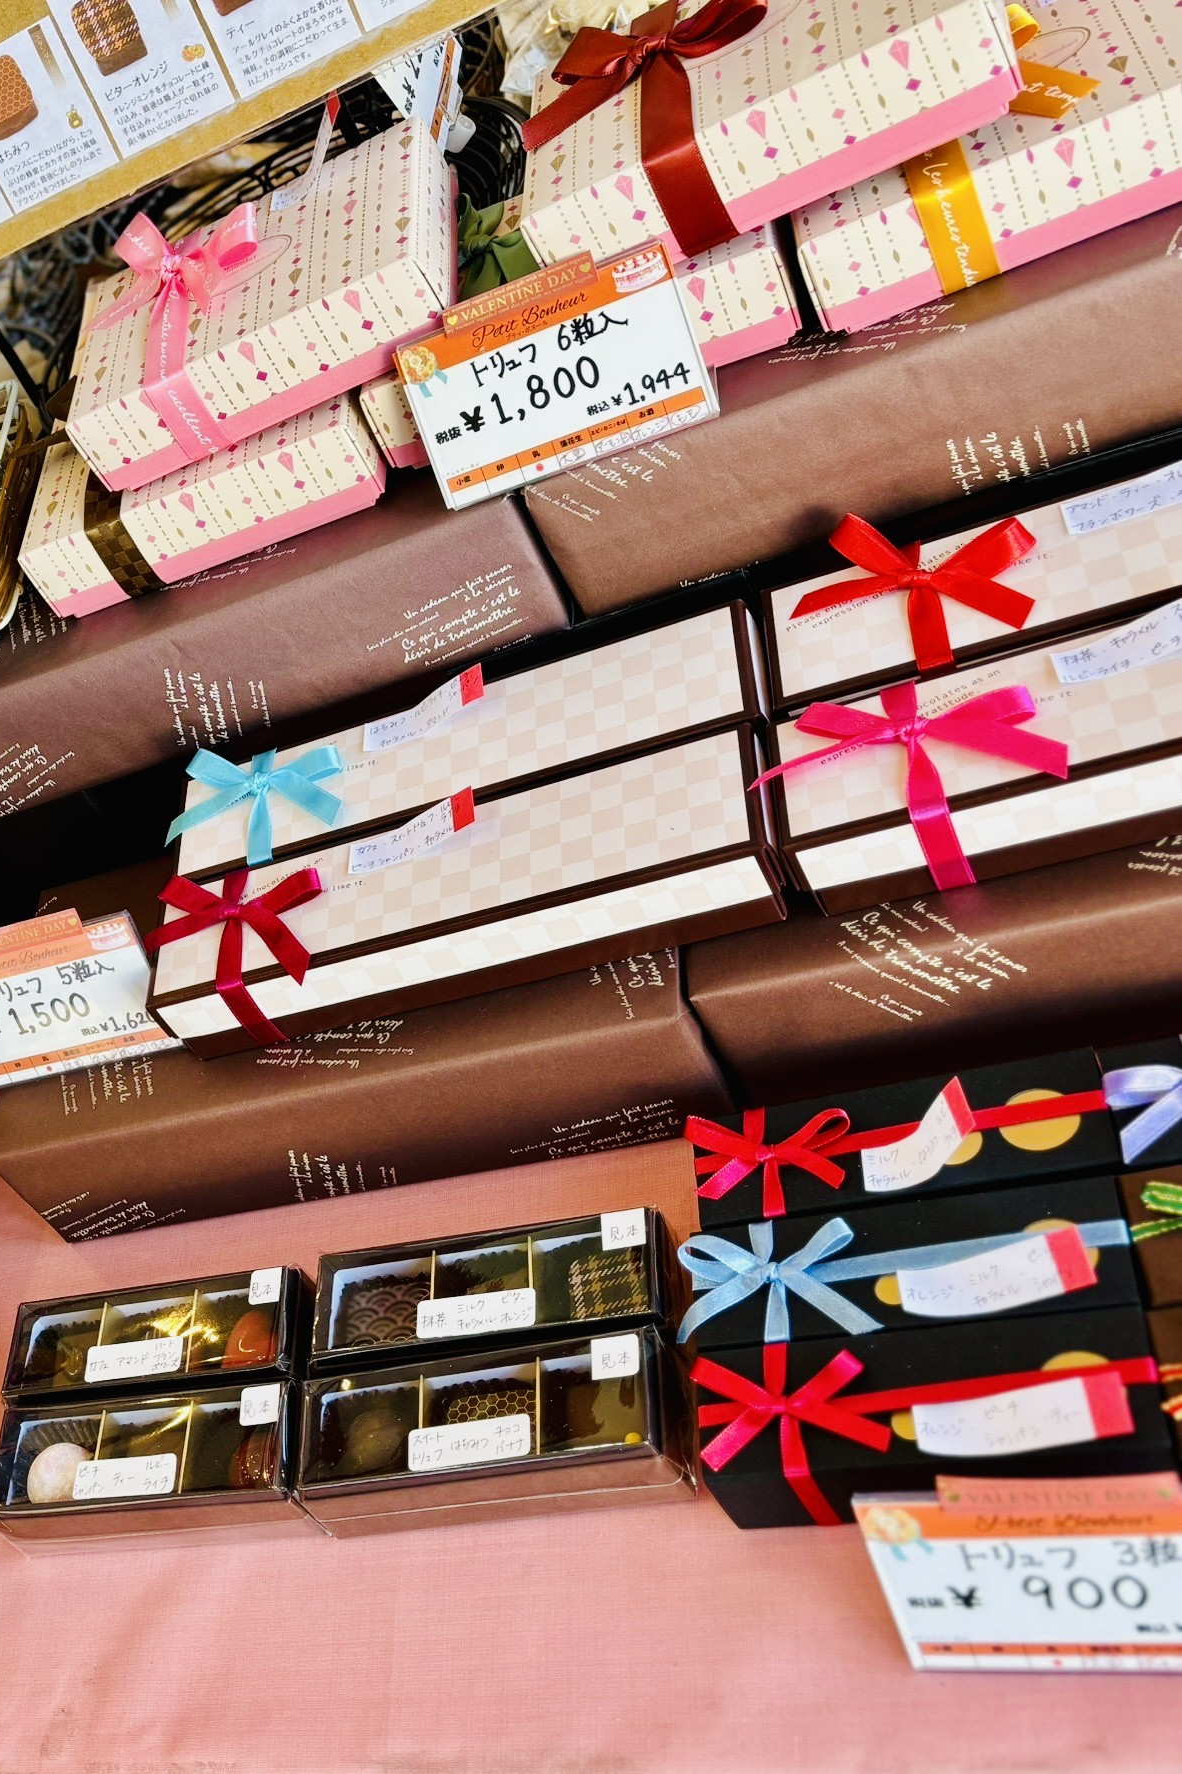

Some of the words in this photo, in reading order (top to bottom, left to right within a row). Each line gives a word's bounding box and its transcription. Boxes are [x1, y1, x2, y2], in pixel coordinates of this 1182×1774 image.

[226, 20, 255, 40] ティー
[104, 60, 169, 102] ビターオレンジ
[460, 282, 545, 321] VALENTINE
[547, 268, 578, 302] DAY
[472, 317, 519, 349] Petit
[521, 291, 590, 326] Bonheur
[470, 343, 537, 388] トリュフ
[556, 310, 629, 352] 6粒入
[586, 400, 611, 417] 税込
[434, 424, 463, 446] 税抜
[785, 610, 823, 633] Please
[44, 918, 70, 936] DAY
[18, 945, 70, 966] Bonheur
[56, 958, 116, 986] 5粒入
[958, 1541, 1077, 1572] トリュフ
